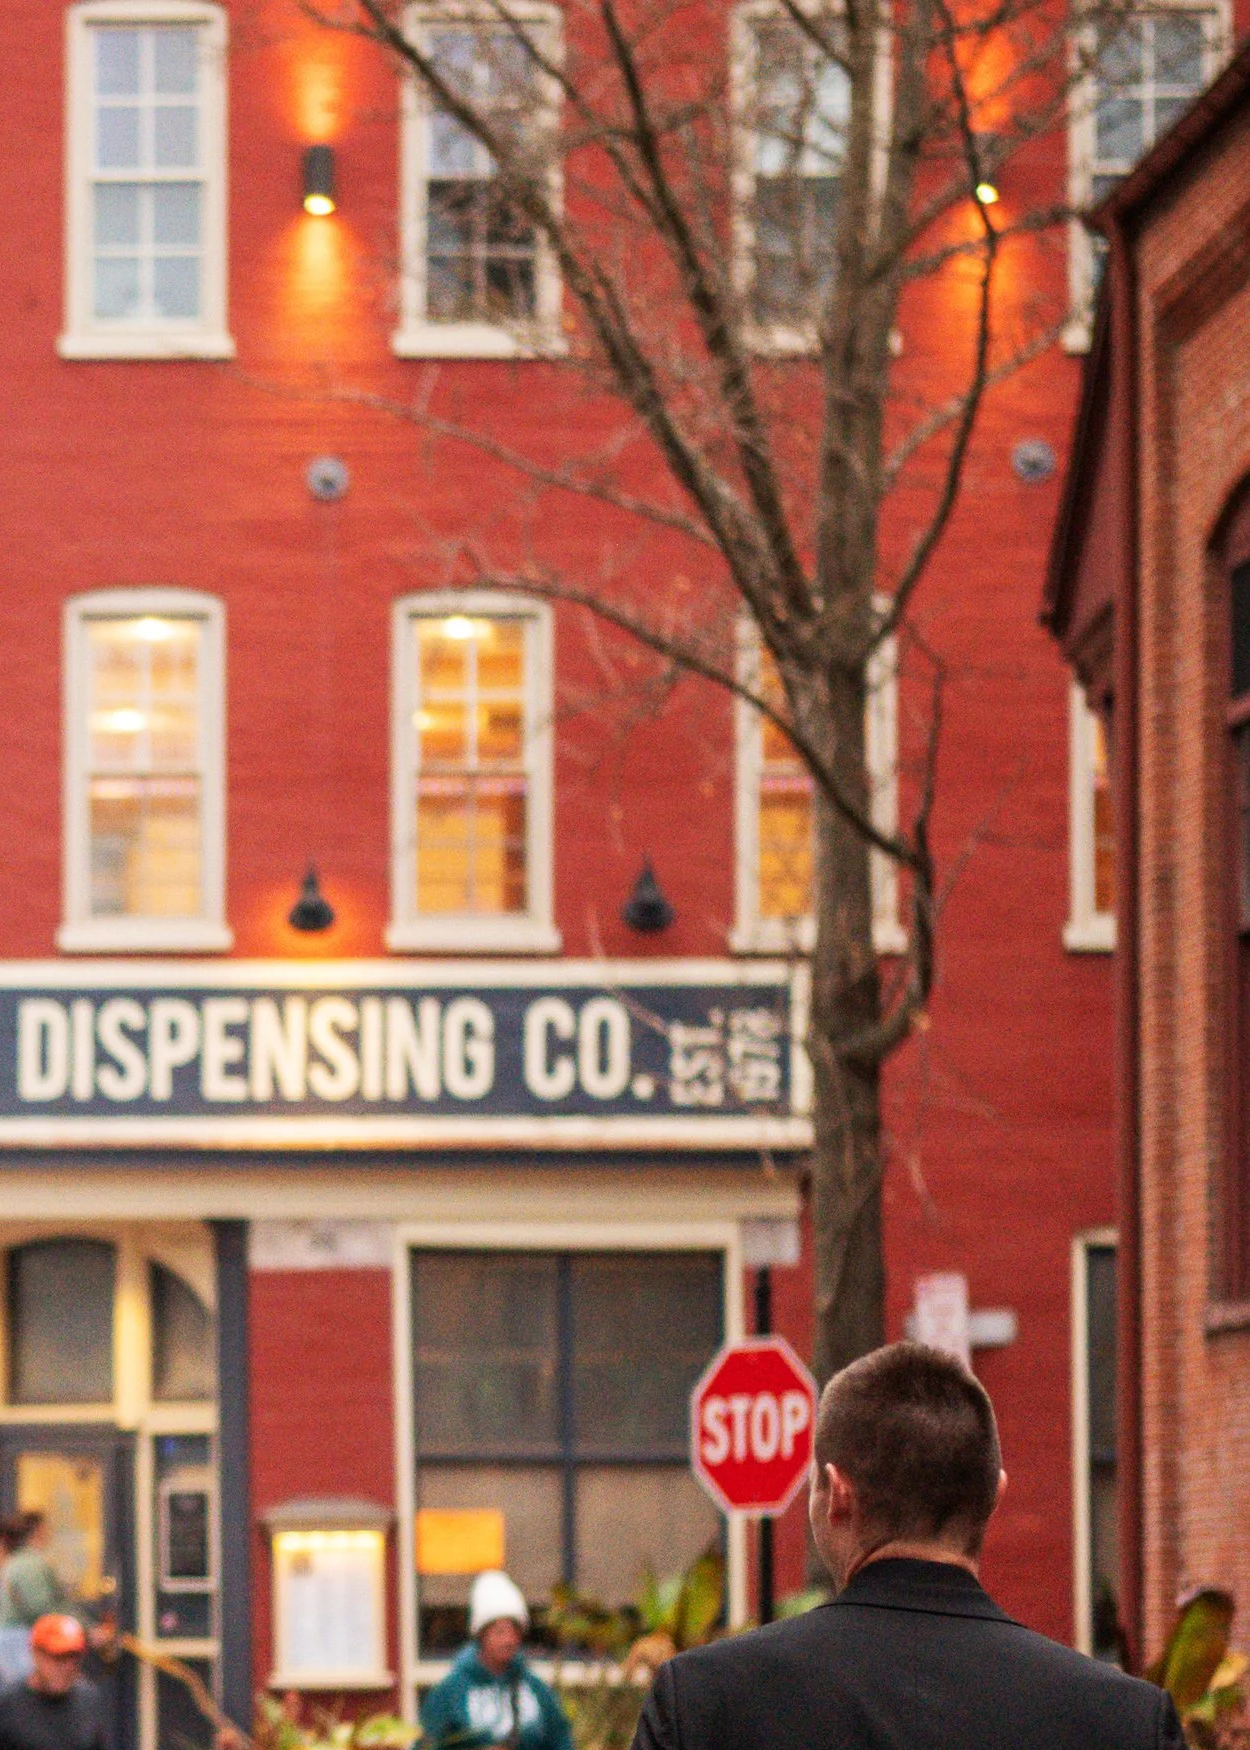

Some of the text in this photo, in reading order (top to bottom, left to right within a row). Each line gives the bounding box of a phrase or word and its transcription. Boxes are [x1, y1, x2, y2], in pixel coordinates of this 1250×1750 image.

[17, 996, 495, 1101] DISPENSING
[523, 996, 655, 1100] CO.
[669, 1007, 725, 1105] EST.
[702, 1392, 809, 1466] STOP
